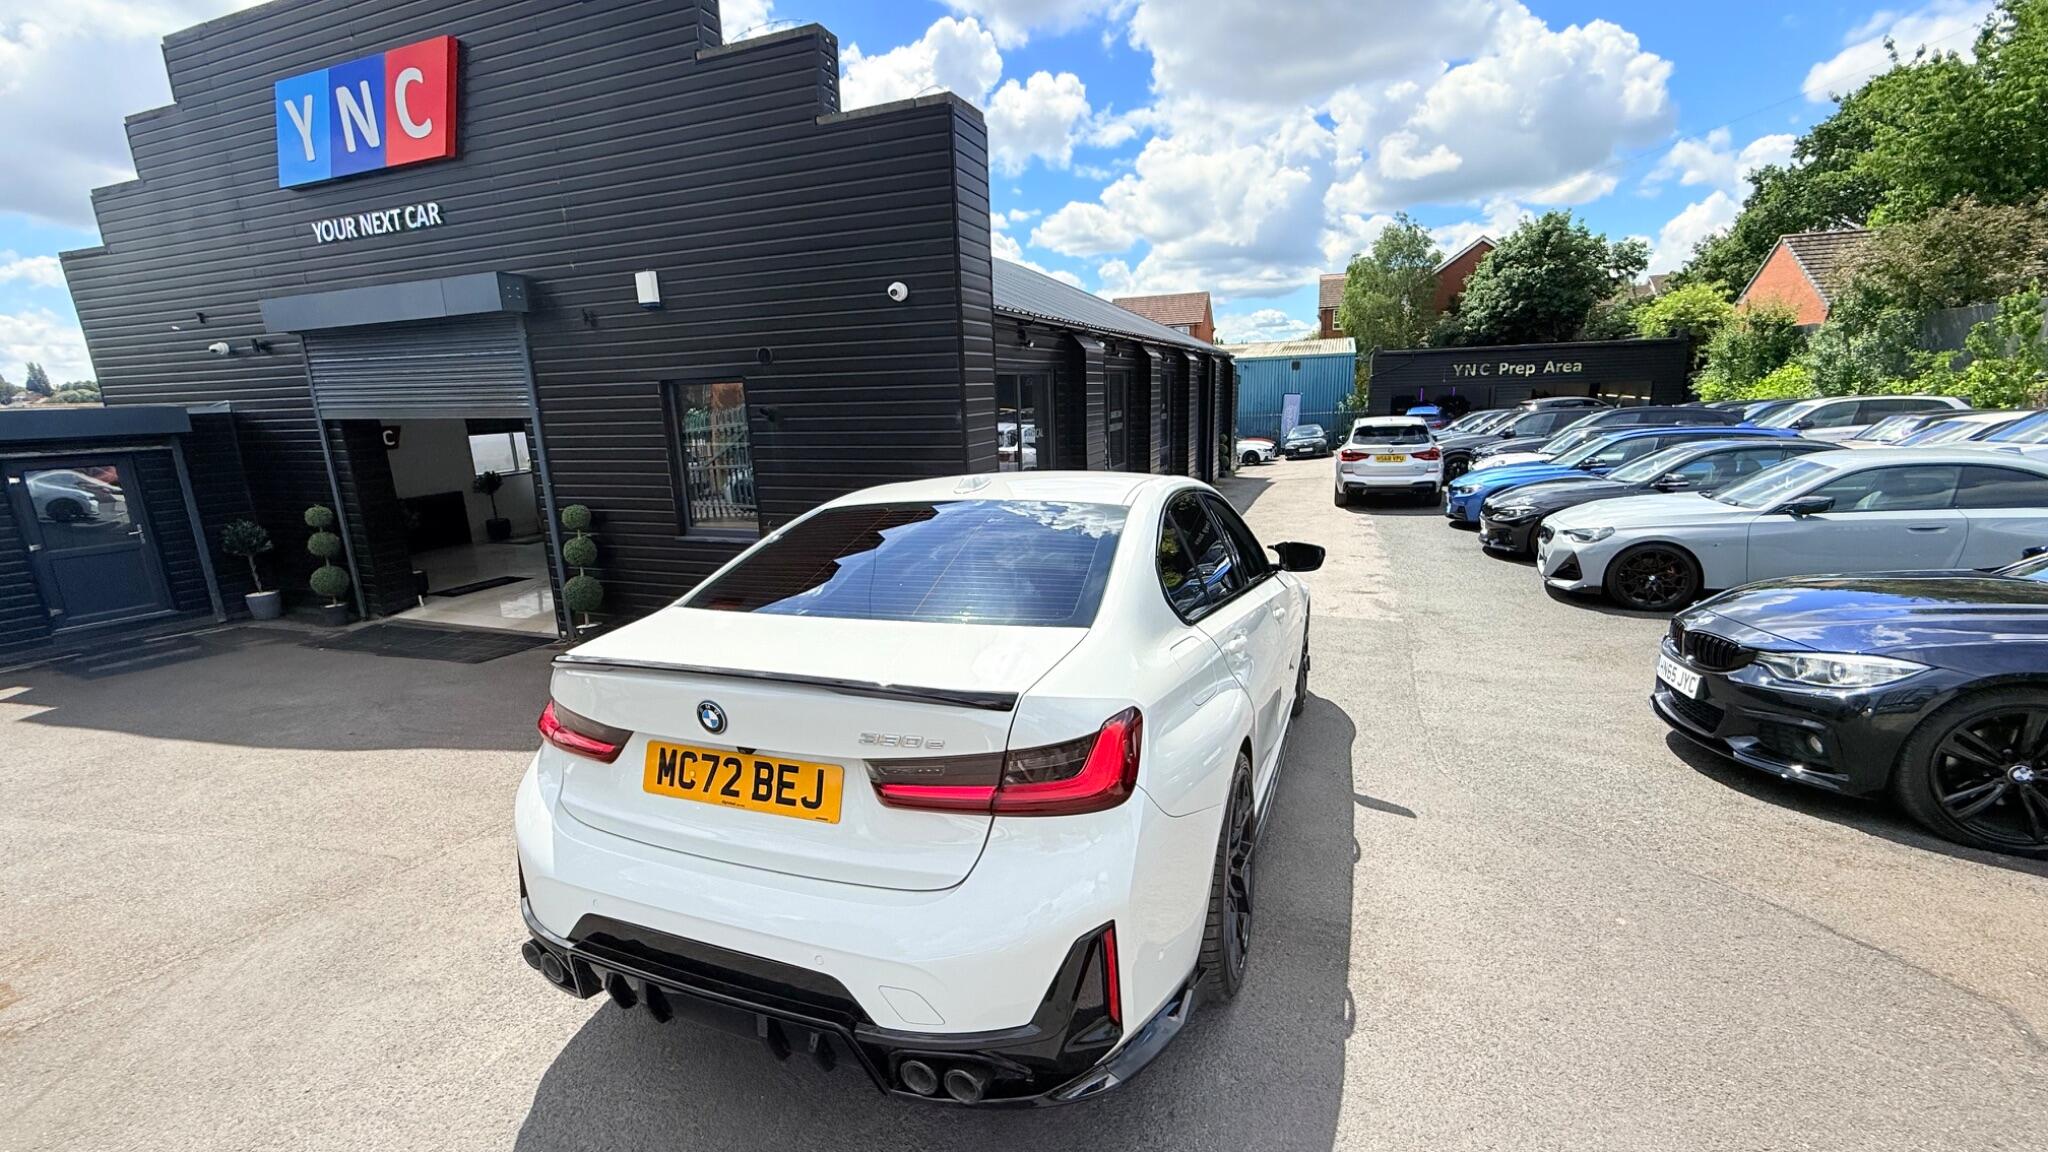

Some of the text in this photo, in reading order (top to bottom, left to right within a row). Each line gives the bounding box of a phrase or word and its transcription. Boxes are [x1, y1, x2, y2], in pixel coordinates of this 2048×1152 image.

[283, 67, 433, 161] YNC
[312, 202, 443, 243] YOUR NEXT CAR
[1453, 360, 1583, 377] YNC Prep Area
[1677, 671, 1696, 693] JYC
[657, 747, 825, 810] MC72 BEJ
